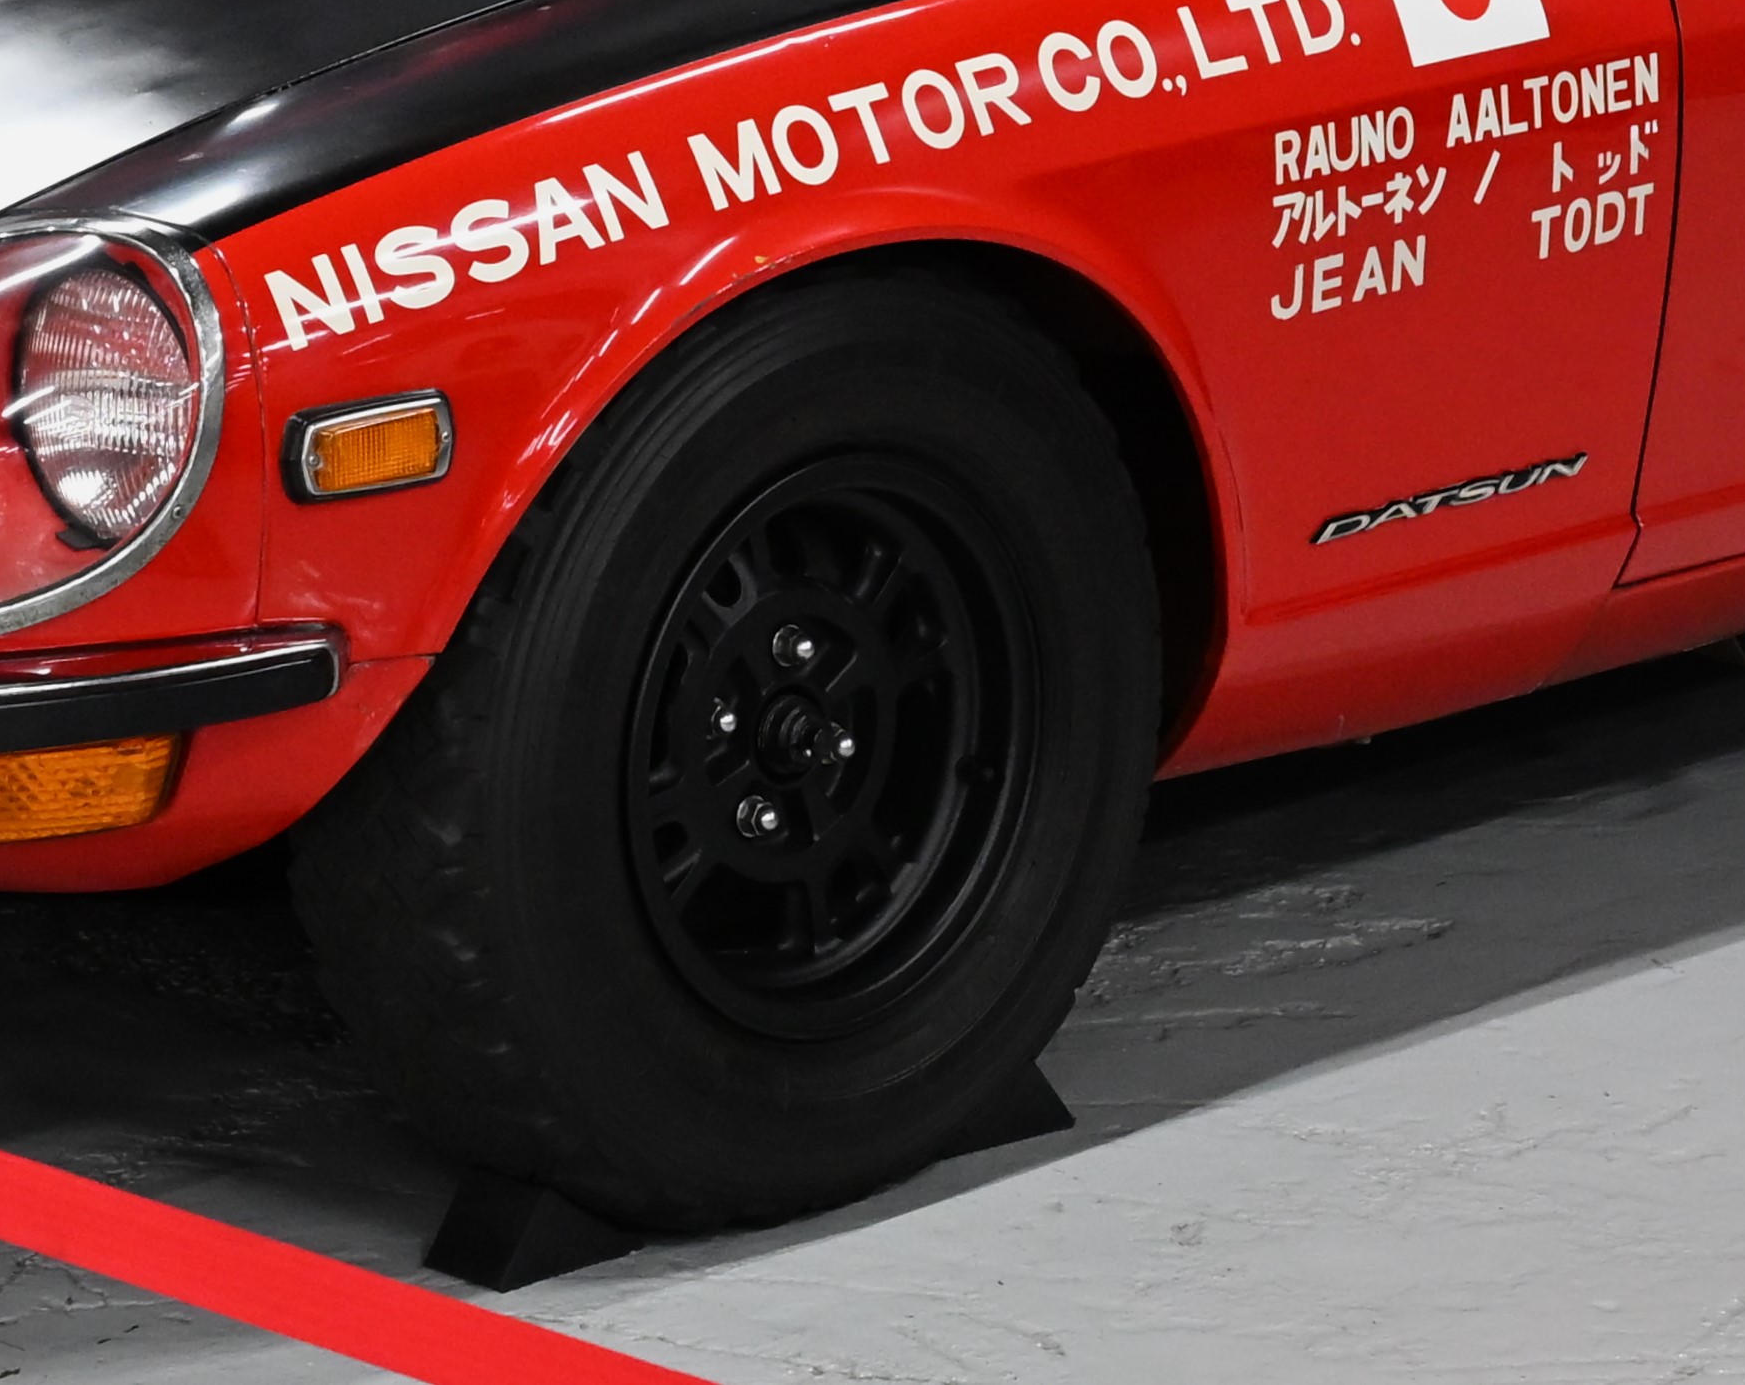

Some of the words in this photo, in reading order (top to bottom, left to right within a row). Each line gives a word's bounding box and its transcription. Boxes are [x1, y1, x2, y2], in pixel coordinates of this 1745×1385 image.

[1274, 106, 1415, 186] RAUNO
[1445, 51, 1660, 149] AALTONEN
[263, 148, 672, 352] NISSAN
[687, 48, 1030, 204] MOTOR
[1270, 235, 1427, 322] JEAN
[1530, 182, 1656, 261] TODT
[1309, 451, 1589, 545] DATSUN
